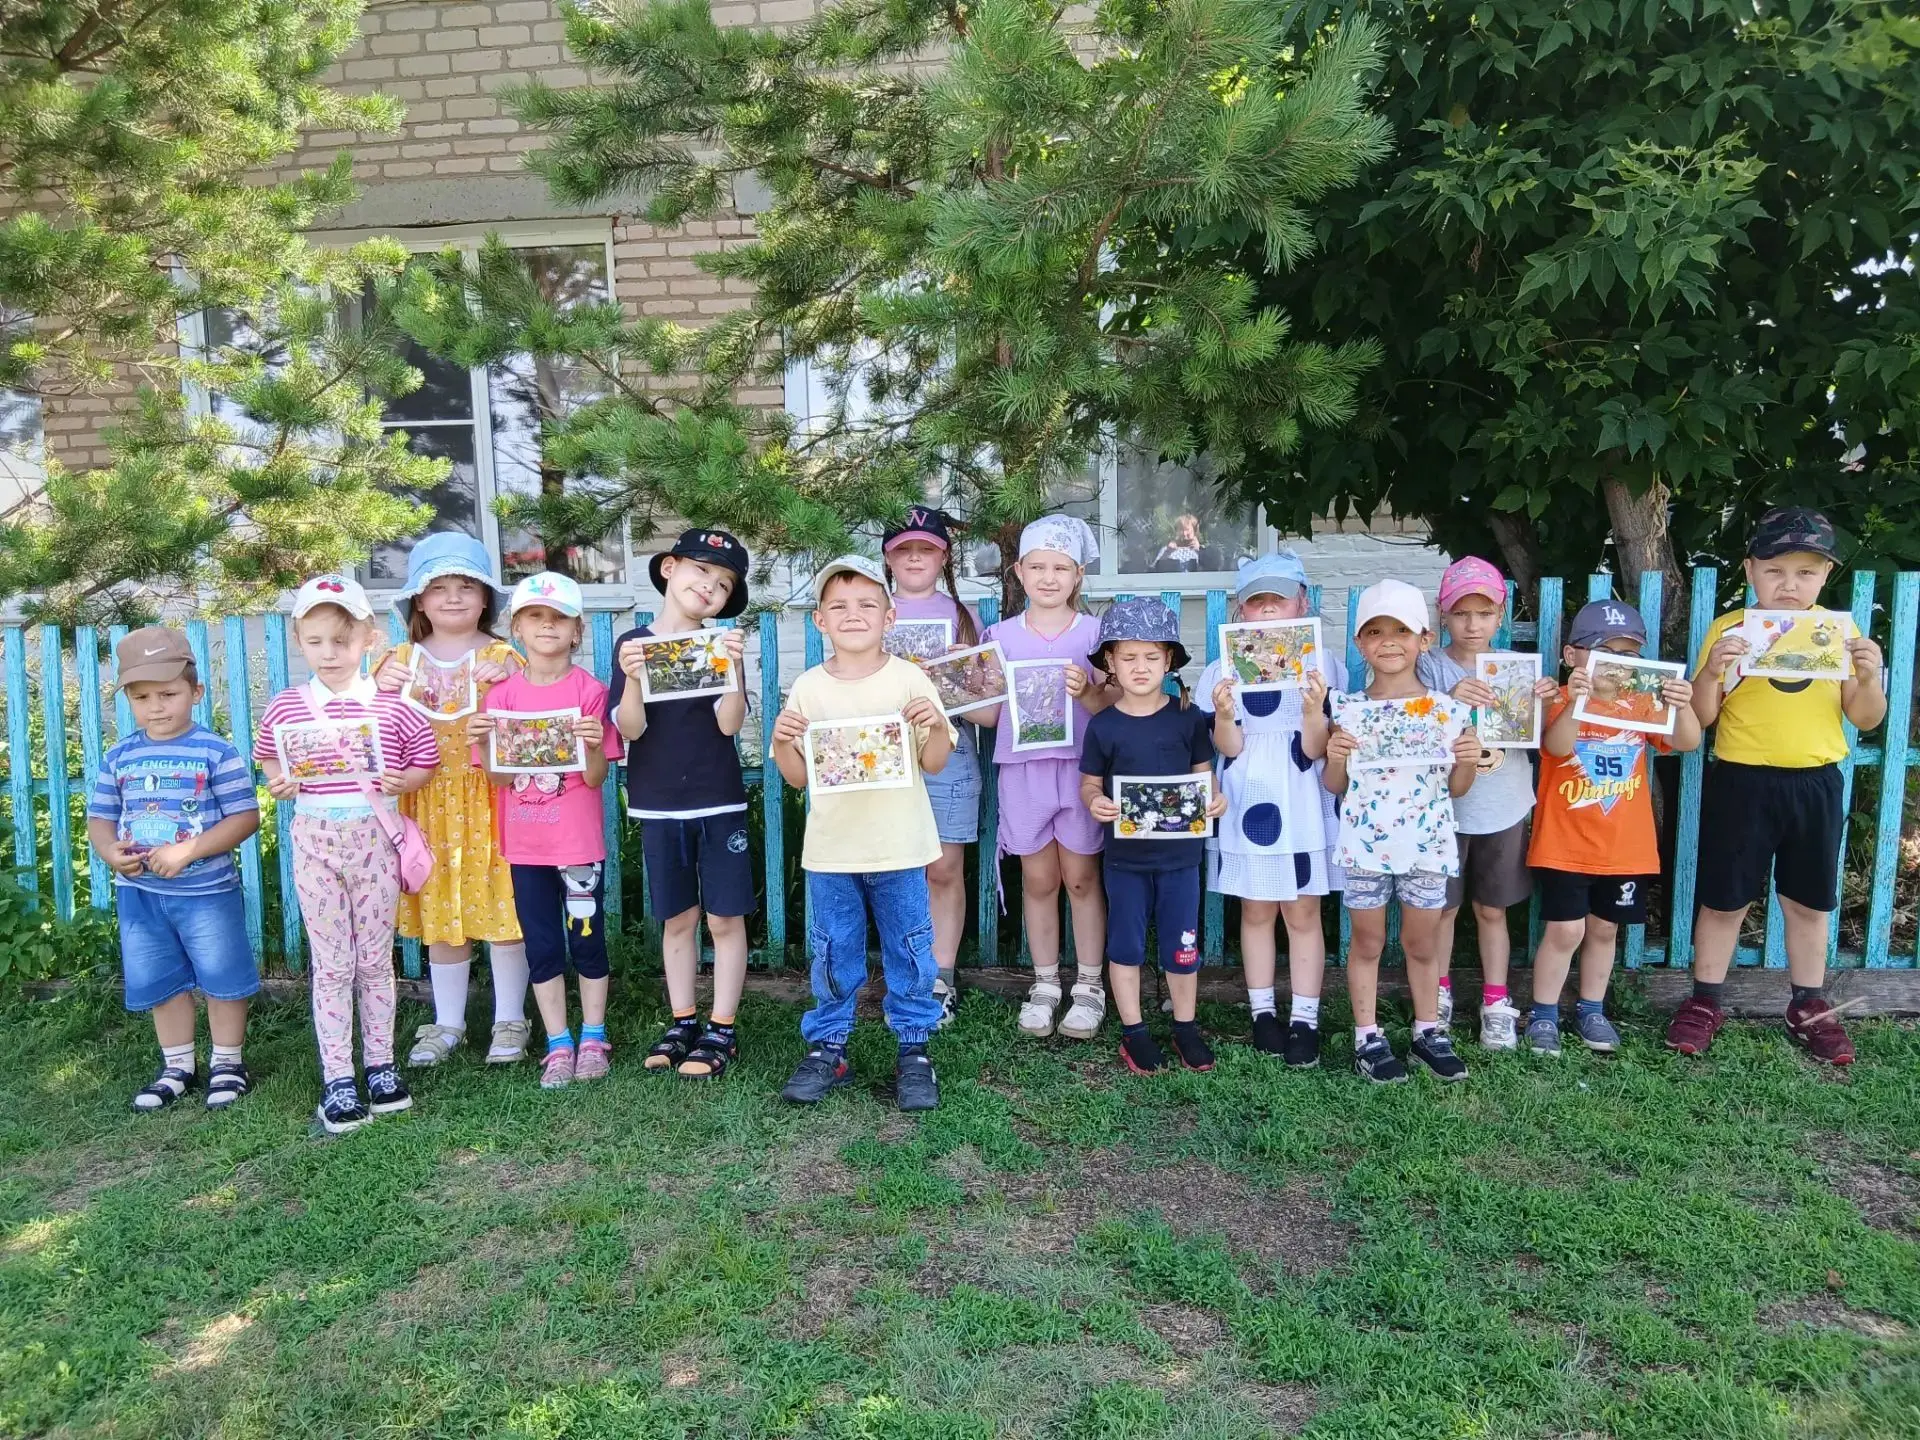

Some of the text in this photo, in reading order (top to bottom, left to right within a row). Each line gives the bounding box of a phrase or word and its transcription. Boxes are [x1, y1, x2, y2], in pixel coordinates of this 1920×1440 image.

[904, 509, 929, 527] N
[1601, 605, 1626, 626] LA
[1588, 743, 1628, 754] EXCLUSIVE
[142, 760, 206, 771] ENGLAND
[1594, 754, 1623, 777] 95
[1559, 774, 1642, 804] Vintage
[519, 795, 547, 806] Smile
